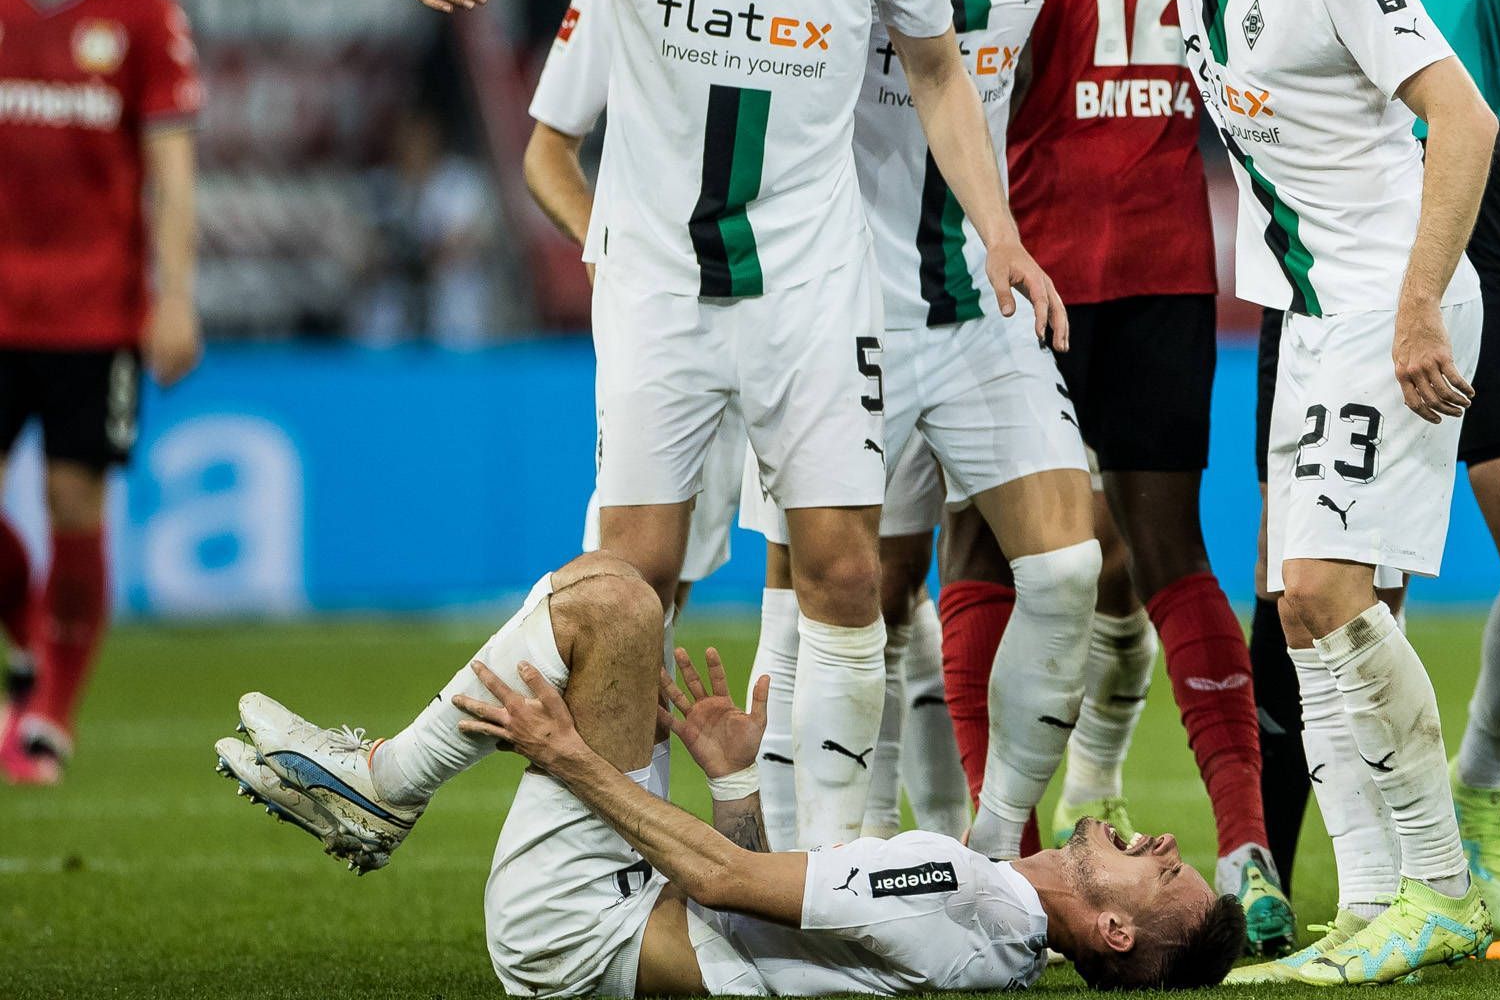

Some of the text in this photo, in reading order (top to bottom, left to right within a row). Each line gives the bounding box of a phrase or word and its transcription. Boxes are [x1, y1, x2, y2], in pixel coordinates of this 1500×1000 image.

[662, 39, 827, 79] Invest in yourself
[879, 86, 914, 107] Inve
[856, 336, 884, 416] 5
[1295, 402, 1385, 485] 23
[875, 870, 952, 890] sonepar
